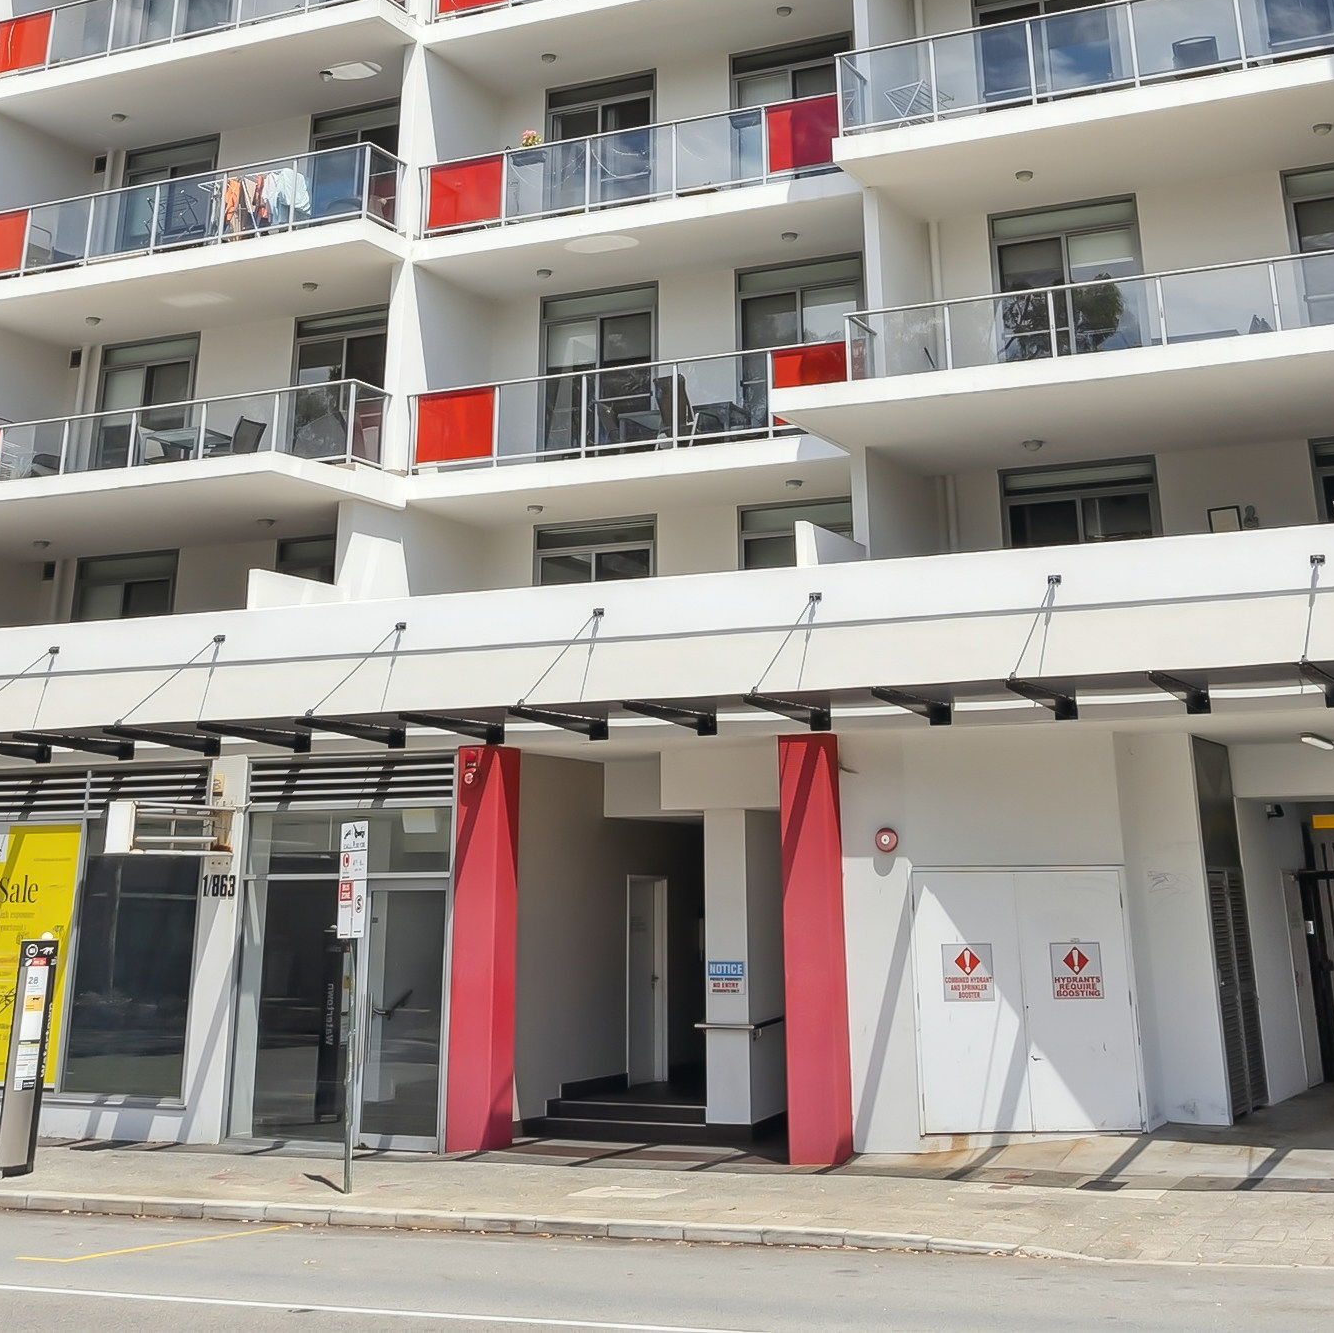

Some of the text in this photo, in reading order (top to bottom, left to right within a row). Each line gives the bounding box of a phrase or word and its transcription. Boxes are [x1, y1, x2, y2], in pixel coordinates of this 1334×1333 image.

[202, 874, 236, 897] 1/863
[709, 963, 743, 975] NOTICE
[969, 976, 993, 984] HYDRANT
[1054, 976, 1101, 984] HYDRANTS
[1059, 983, 1097, 991] REQUIRE
[958, 991, 981, 999] BOOSTER
